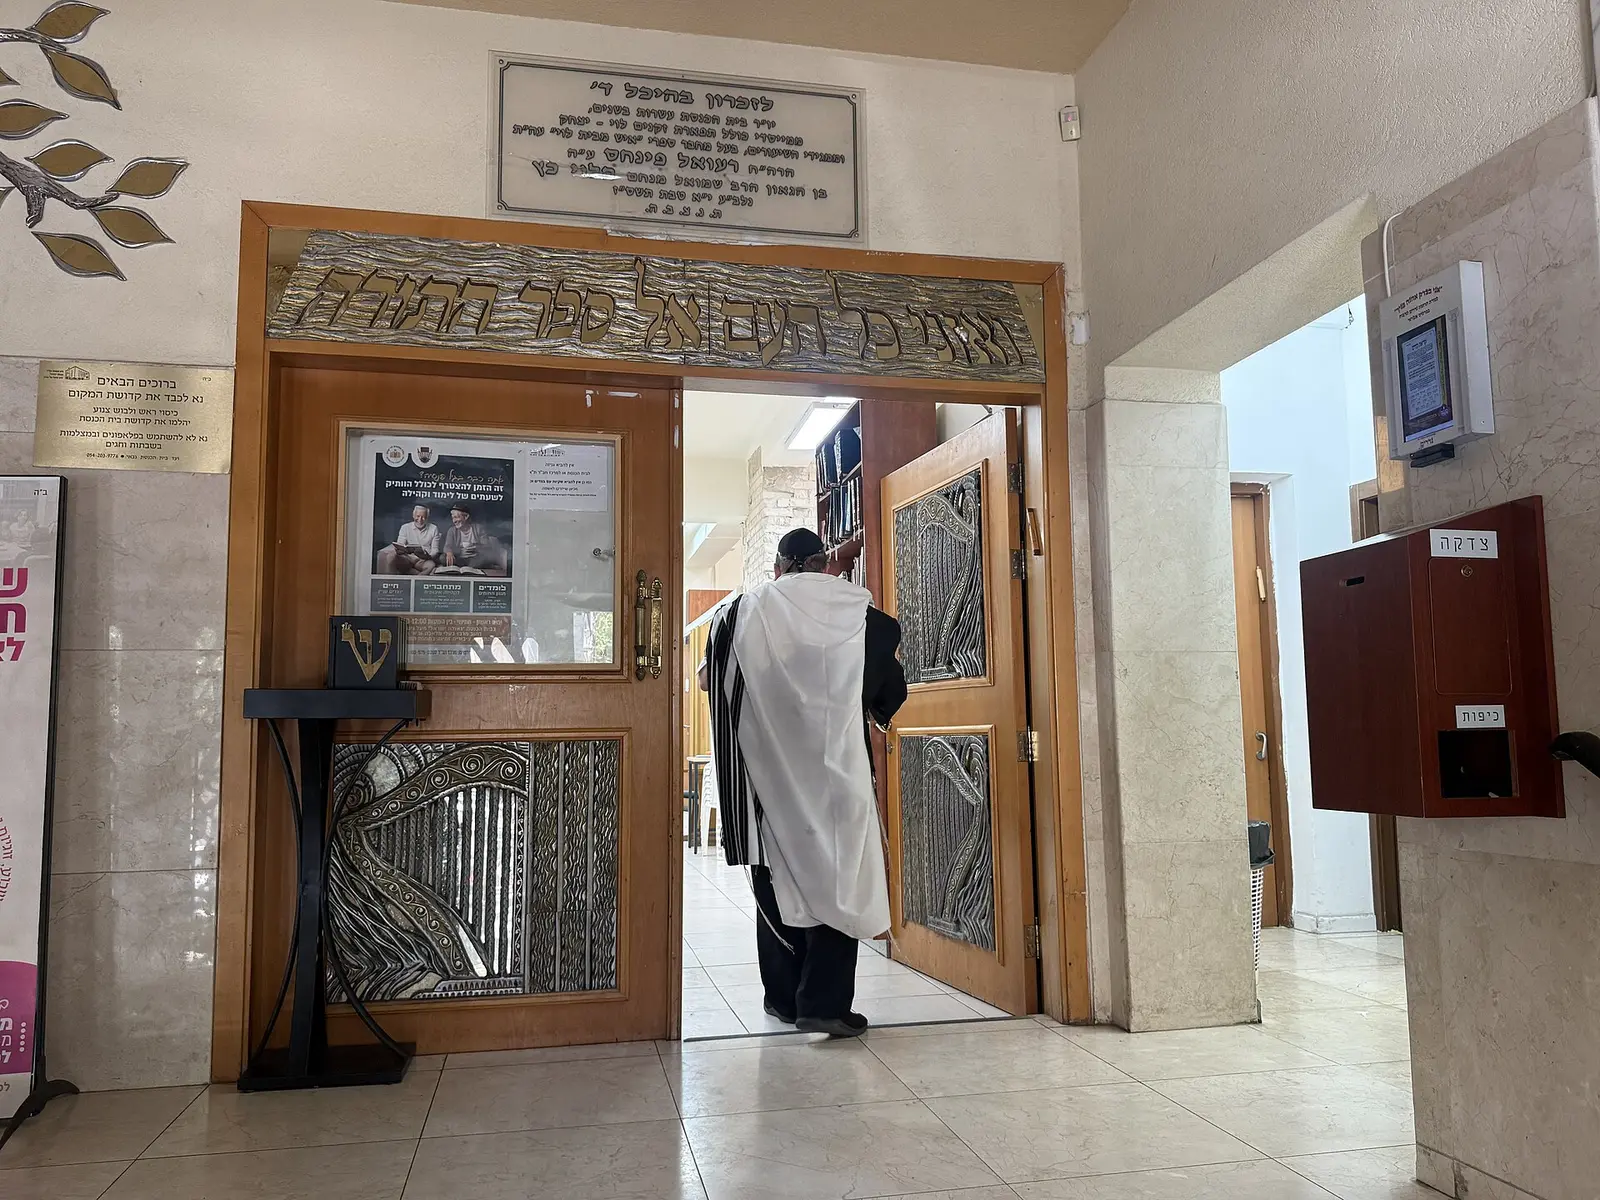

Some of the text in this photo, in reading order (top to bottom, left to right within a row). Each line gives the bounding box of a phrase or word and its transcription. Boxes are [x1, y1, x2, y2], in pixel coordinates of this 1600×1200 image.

[624, 82, 695, 104] בהיכל
[705, 93, 774, 111] לזכרון
[559, 114, 591, 126] יצחק
[636, 107, 675, 121] עשרות
[680, 111, 720, 125] הכנסת
[609, 119, 628, 130] לוי
[633, 120, 668, 135] זקנים
[726, 116, 748, 127] בית
[578, 130, 610, 143] מבית
[674, 125, 717, 138] תפארת
[721, 128, 749, 141] כולל
[648, 136, 676, 148] ספרי
[681, 138, 713, 152] מחבר
[755, 132, 804, 146] ממייסדי
[717, 141, 739, 154] בעל
[603, 147, 667, 167] פינחס
[677, 152, 740, 173] רעואל
[532, 160, 559, 178] כץ
[626, 171, 667, 185] מנחם
[674, 174, 723, 189] שמואל
[730, 180, 759, 193] הרב
[766, 183, 806, 197] הגאון
[658, 190, 687, 201] טבת
[812, 188, 828, 200] בן
[293, 267, 500, 336] התורה
[634, 256, 702, 348] אל
[519, 278, 616, 343] ספר
[824, 269, 902, 361] כל
[720, 294, 828, 367] העם
[97, 377, 177, 389] ברוכים הבאים
[68, 389, 204, 403] נא לכבד את קדושת המקום
[92, 406, 111, 414] צנוע
[113, 407, 136, 415] ולבוש
[159, 409, 179, 417] כיסוי
[79, 415, 105, 423] הכנסת
[124, 417, 152, 426] קדושת
[169, 418, 191, 426] יהלמו
[59, 429, 100, 438] ובמצלמות
[102, 431, 144, 440] בפלאפונים
[146, 433, 184, 441] להשתמש
[129, 441, 162, 450] בשבתות
[385, 480, 503, 492] זה הזמן להצטרף לכולל הוותיק
[402, 489, 431, 498] וקהילה
[433, 491, 454, 499] לימוד
[471, 493, 503, 501] לשעתים
[1439, 535, 1489, 553] צדקה
[1461, 709, 1500, 723] כיפות
